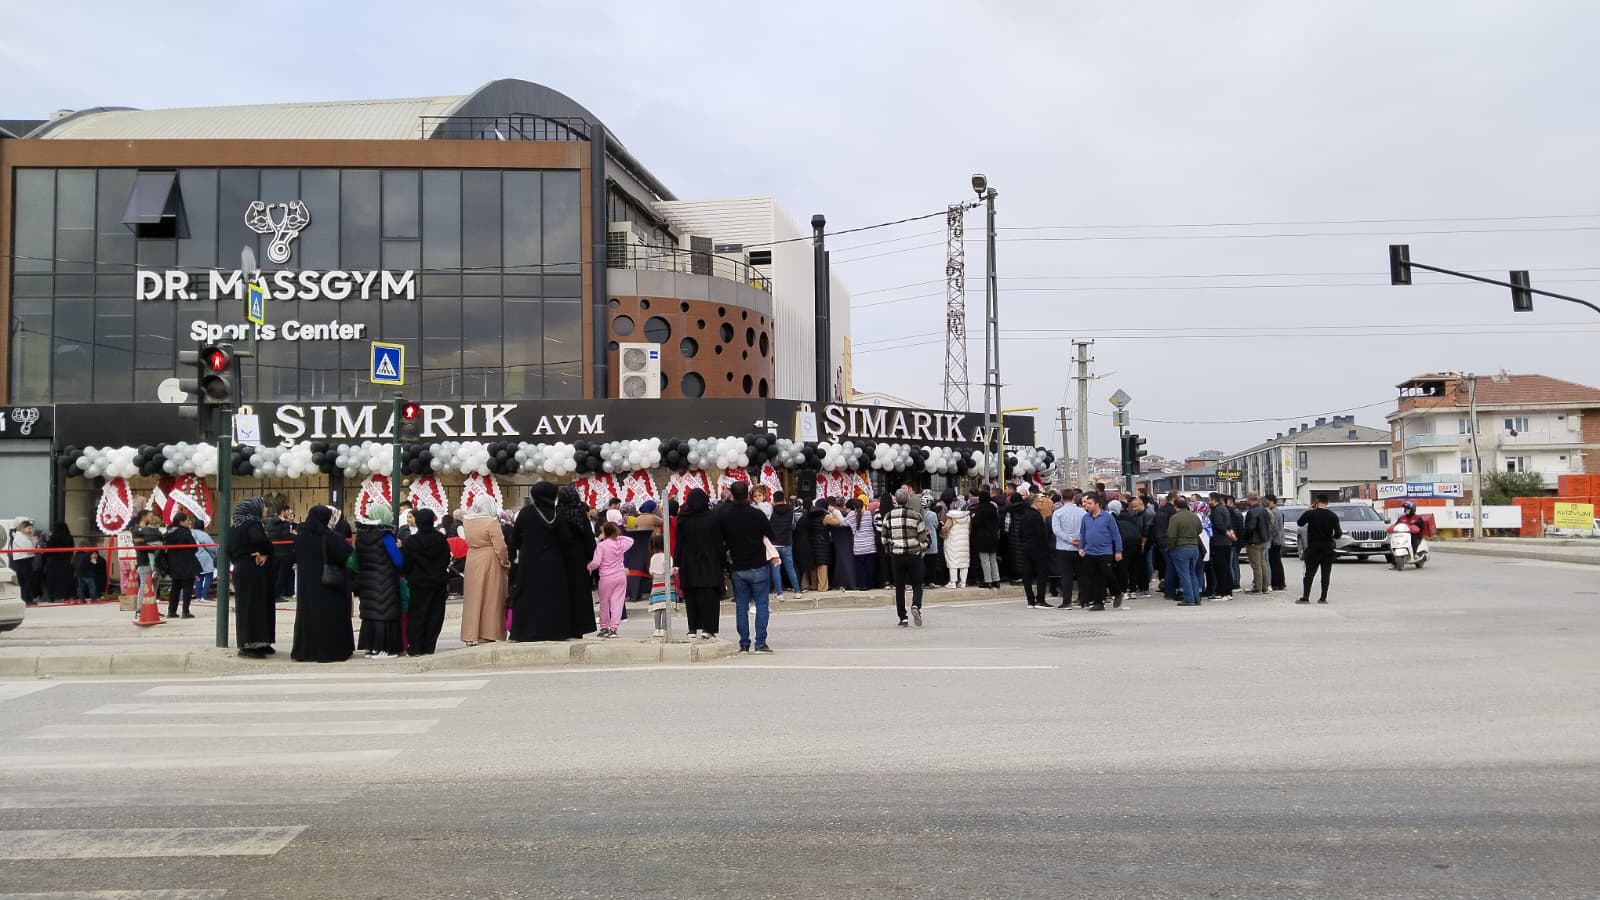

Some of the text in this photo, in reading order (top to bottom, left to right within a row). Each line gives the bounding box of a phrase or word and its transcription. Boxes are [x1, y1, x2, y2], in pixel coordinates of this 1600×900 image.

[136, 270, 197, 300] DR.
[190, 319, 365, 345] Sports Center
[532, 414, 605, 435] AVM
[824, 404, 966, 443] ŞIMARIK
